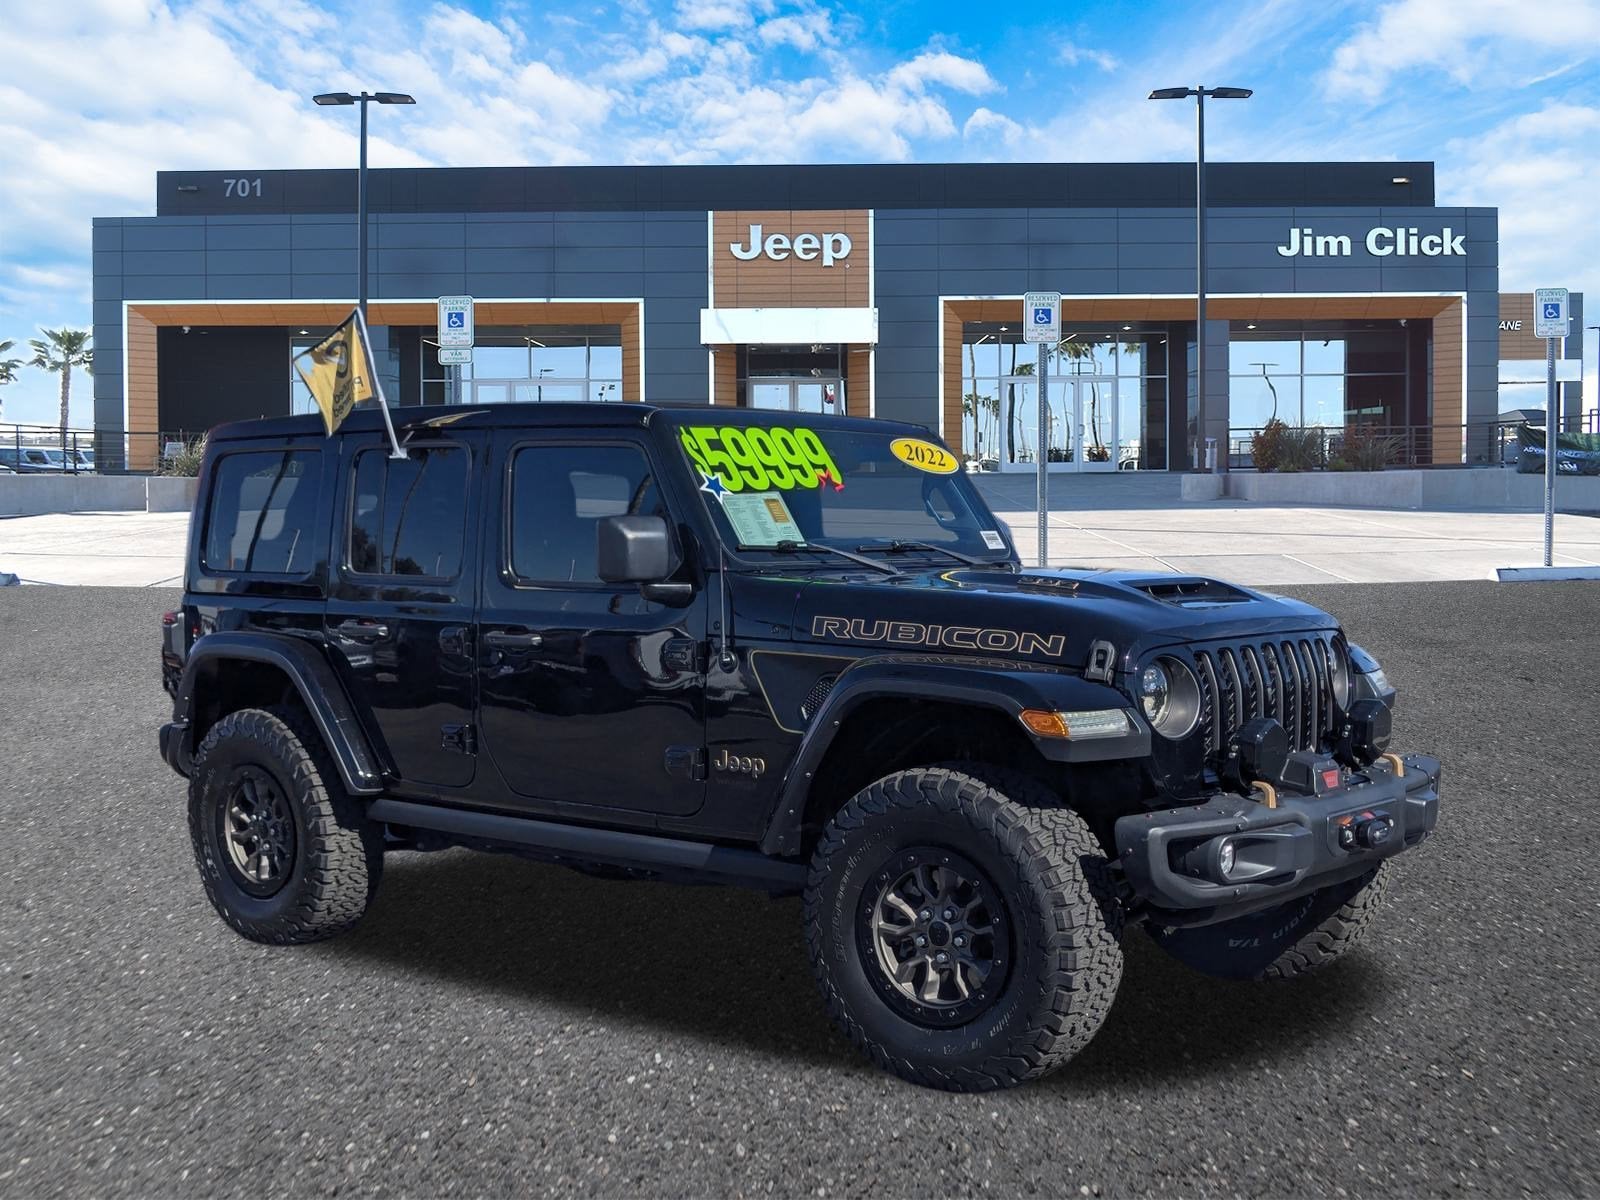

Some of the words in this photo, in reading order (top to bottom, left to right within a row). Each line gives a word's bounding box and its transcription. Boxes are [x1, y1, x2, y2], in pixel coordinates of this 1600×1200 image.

[223, 178, 262, 197] 701
[730, 223, 852, 267] Jeep
[1277, 227, 1352, 257] Jim
[1365, 227, 1467, 257] Click
[679, 425, 844, 493] $59999
[904, 443, 946, 467] 2022
[811, 615, 1066, 656] RUBICON
[714, 749, 765, 779] Jeep
